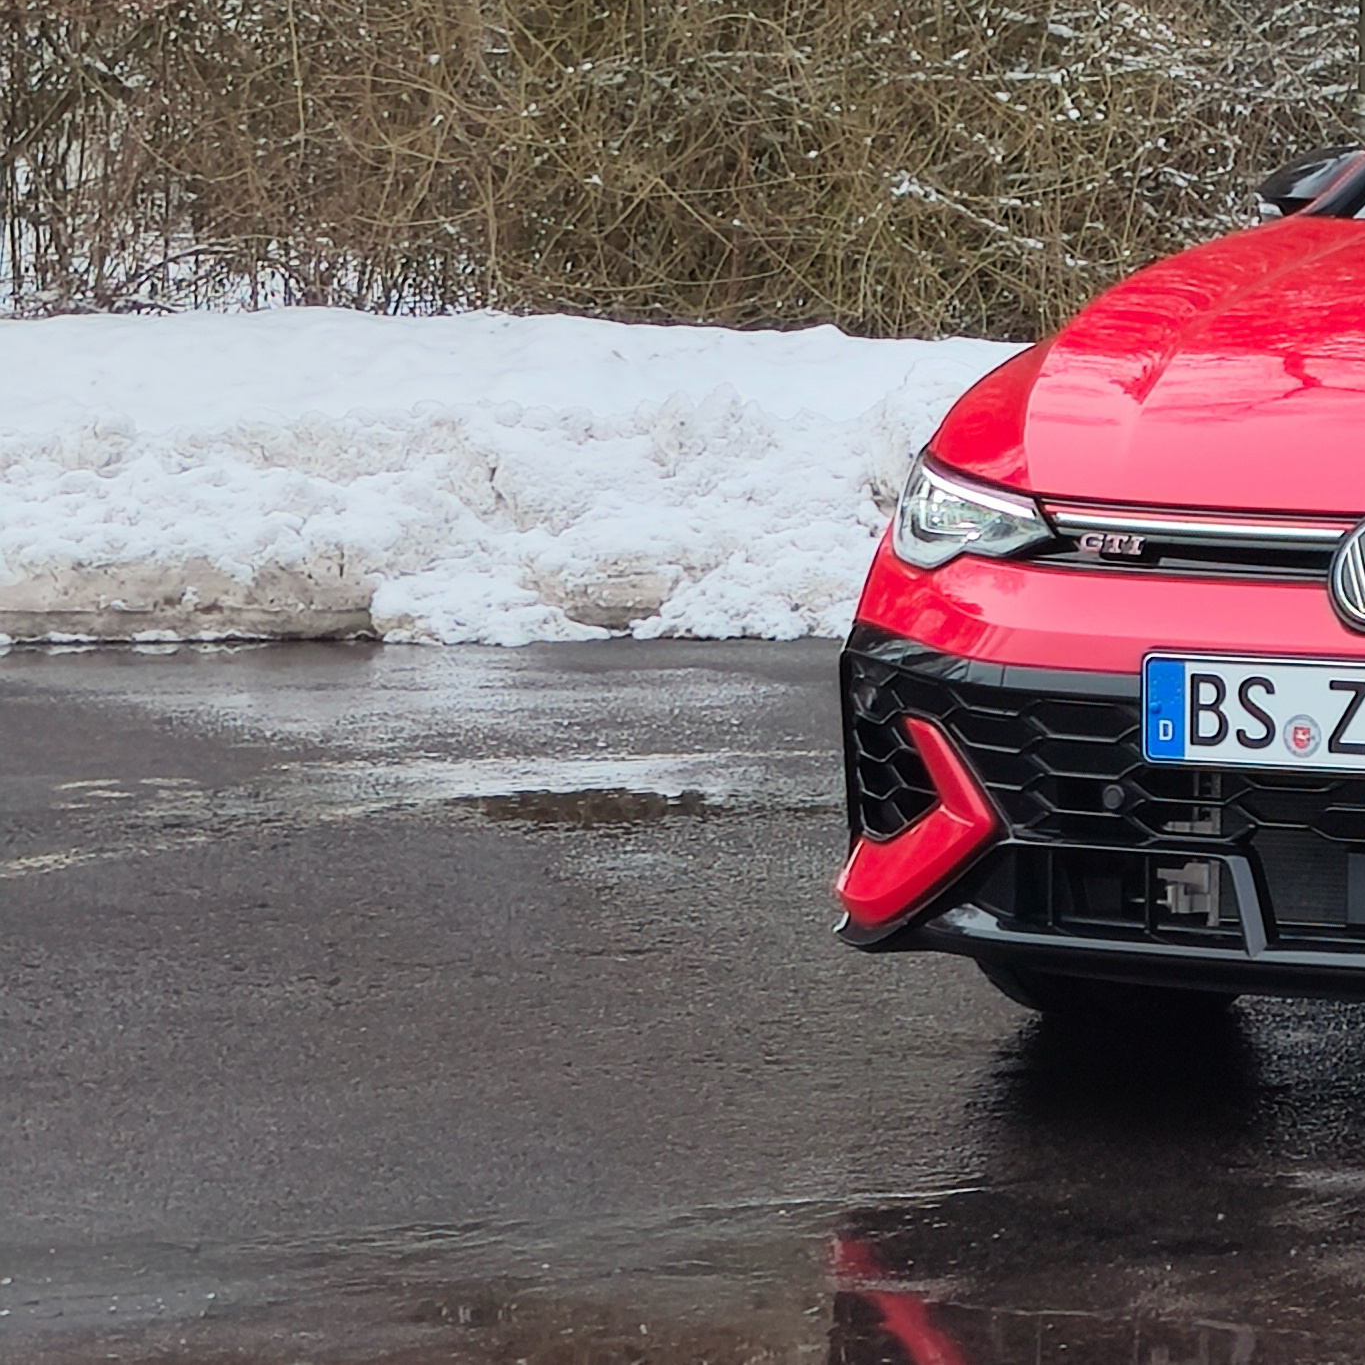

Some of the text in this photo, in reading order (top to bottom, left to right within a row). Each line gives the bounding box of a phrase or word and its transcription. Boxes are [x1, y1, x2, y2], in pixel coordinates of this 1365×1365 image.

[1080, 533, 1146, 555] GTI
[1189, 673, 1276, 749] BS
[1159, 719, 1173, 741] D
